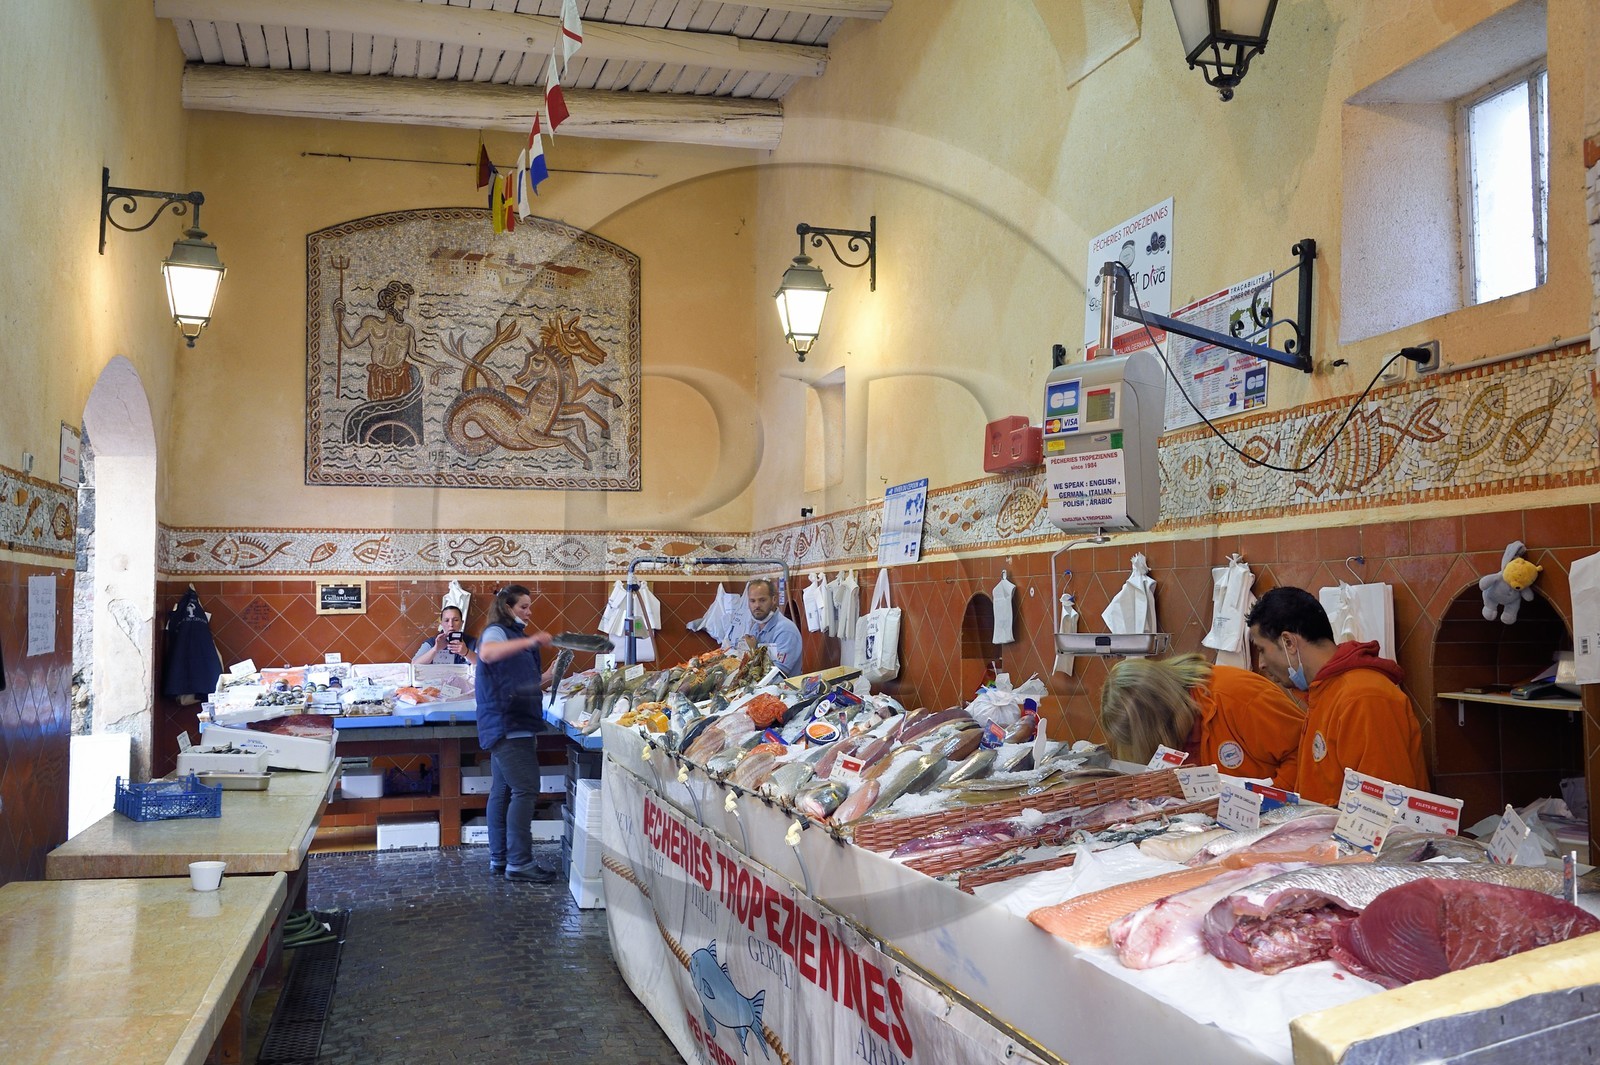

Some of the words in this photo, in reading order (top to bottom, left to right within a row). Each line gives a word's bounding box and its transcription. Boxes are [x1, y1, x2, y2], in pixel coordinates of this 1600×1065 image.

[1123, 205, 1169, 237] TROPEZIENNES
[1064, 418, 1078, 426] VISA
[1079, 452, 1118, 461] TROPEZIENNES
[1065, 481, 1084, 489] SPEAK
[1089, 478, 1117, 487] ENGLISH
[1058, 491, 1083, 499] GERMAN
[1089, 488, 1112, 496] ITALIAN
[1089, 498, 1112, 506] ARABIC
[1415, 802, 1430, 810] FILETS
[1439, 807, 1454, 815] LOUPS
[717, 851, 913, 1059] TROPEZIENNES
